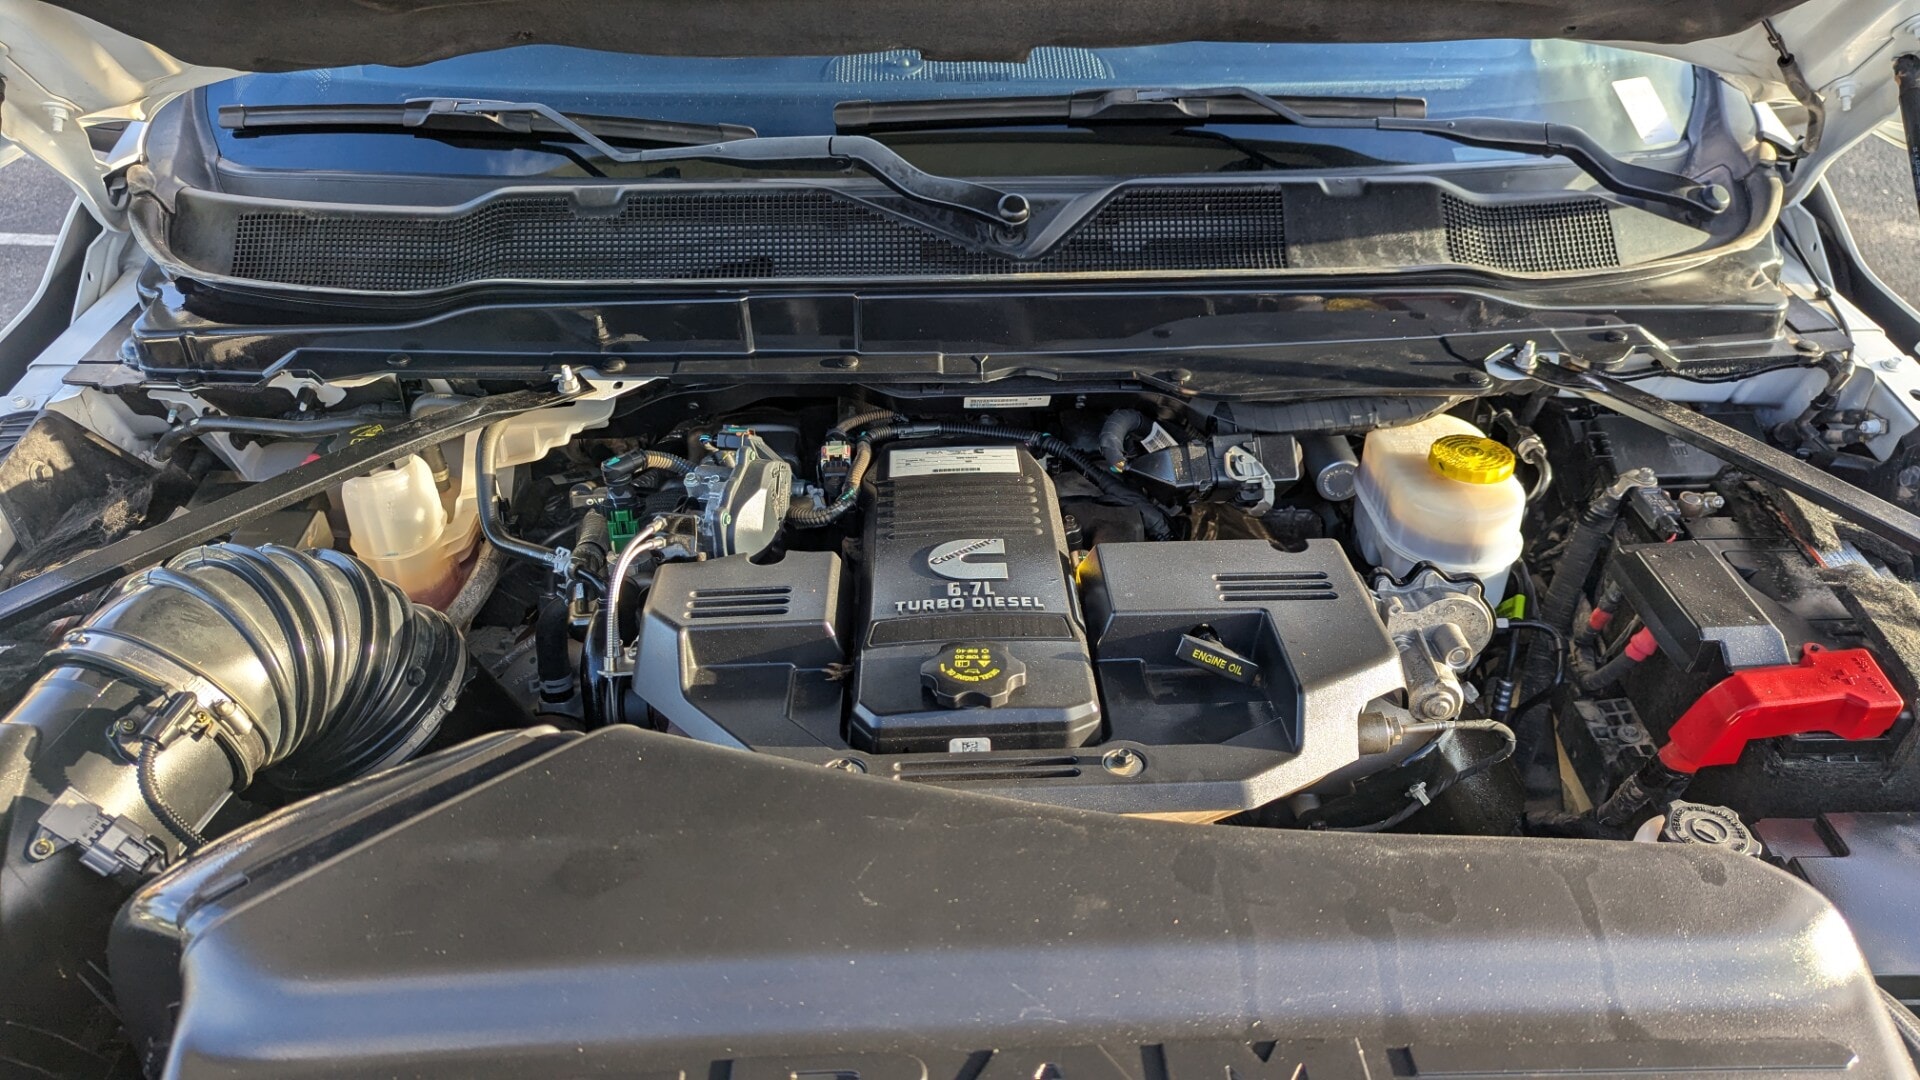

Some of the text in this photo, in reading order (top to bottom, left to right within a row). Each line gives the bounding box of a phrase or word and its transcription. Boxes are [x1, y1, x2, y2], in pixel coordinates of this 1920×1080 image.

[930, 540, 997, 565] Cummins
[947, 581, 996, 597] 6.7L
[895, 596, 1045, 613] TURBO DIESEL
[1192, 648, 1242, 676] ENGINE OIL
